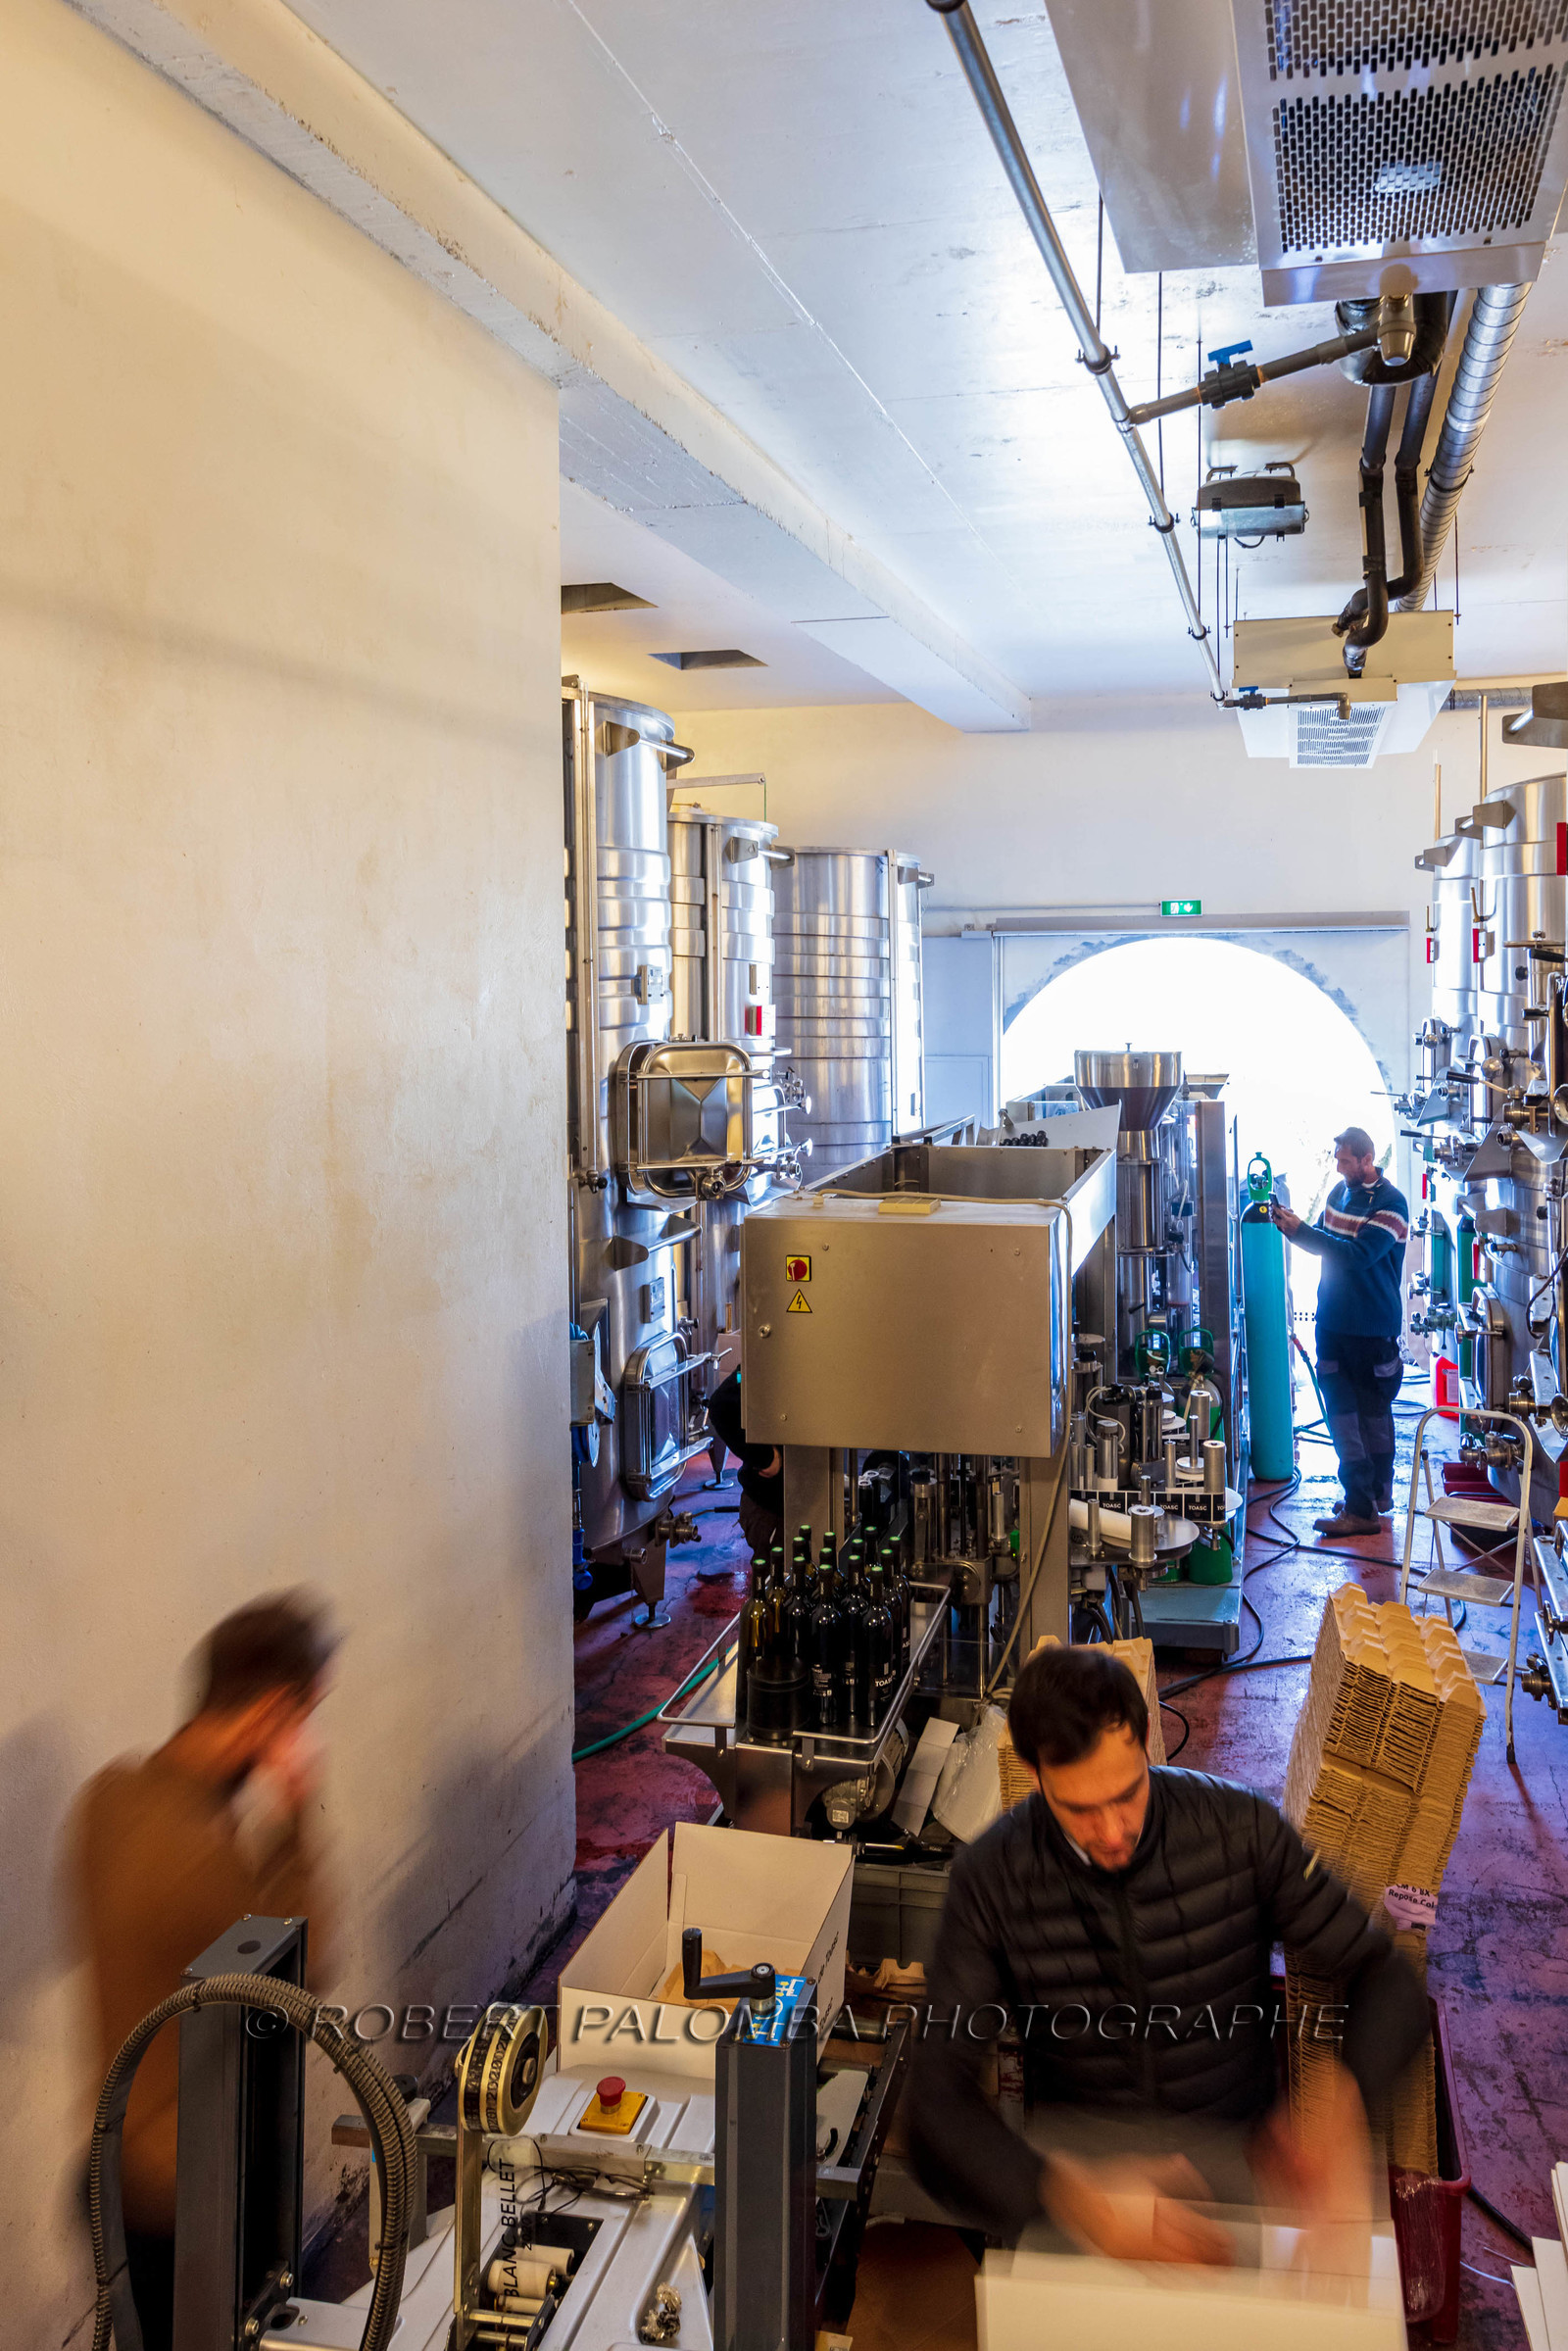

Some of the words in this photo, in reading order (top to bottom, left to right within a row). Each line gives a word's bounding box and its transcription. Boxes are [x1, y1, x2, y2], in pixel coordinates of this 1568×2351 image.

[1388, 1888, 1418, 1903] Repose
[498, 2157, 516, 2229] BELLET
[502, 2233, 520, 2298] BLANC
